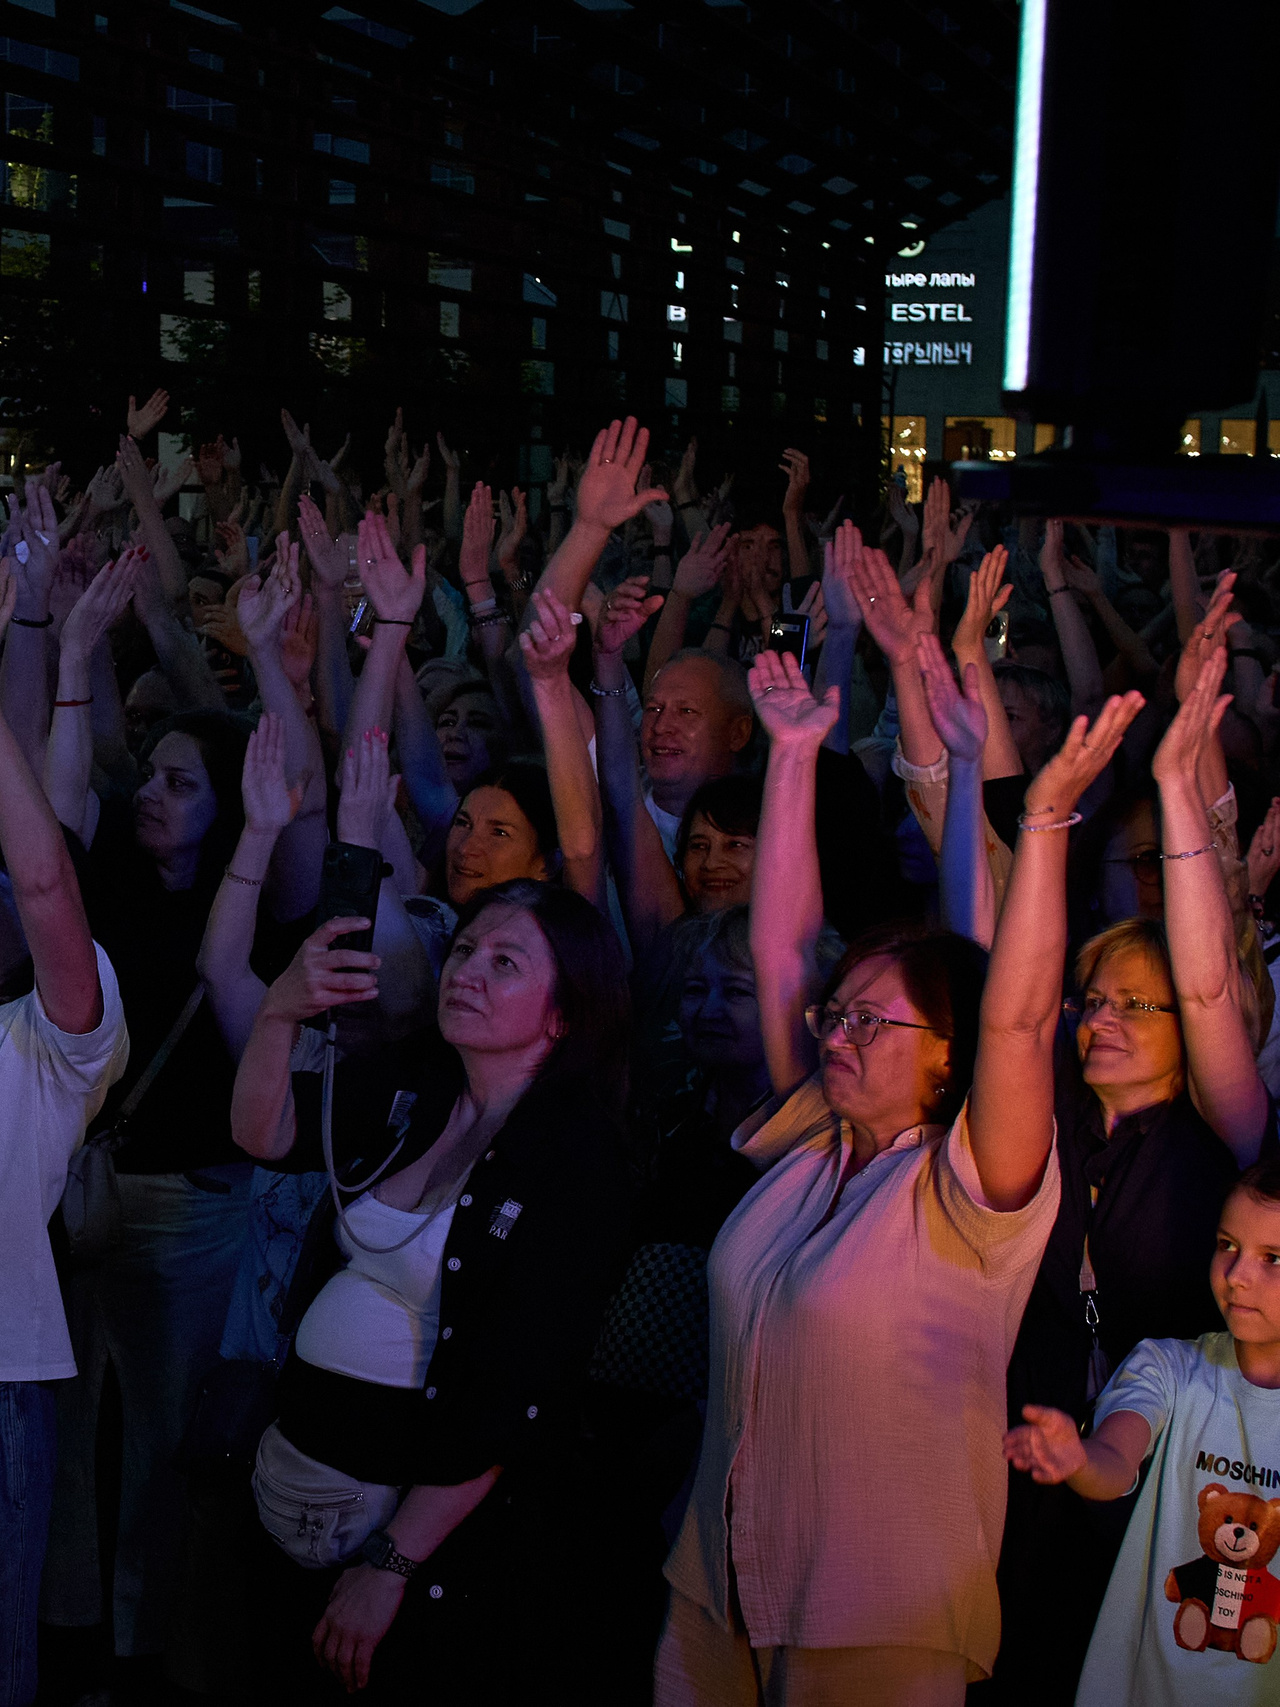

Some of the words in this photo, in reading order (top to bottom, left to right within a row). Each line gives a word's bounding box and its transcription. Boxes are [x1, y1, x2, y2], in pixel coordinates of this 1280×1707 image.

[928, 273, 976, 288] лапы
[891, 303, 974, 323] ESTEL
[1224, 1570, 1233, 1580] IS
[1235, 1573, 1253, 1583] NOT
[1217, 1606, 1236, 1617] TOY
